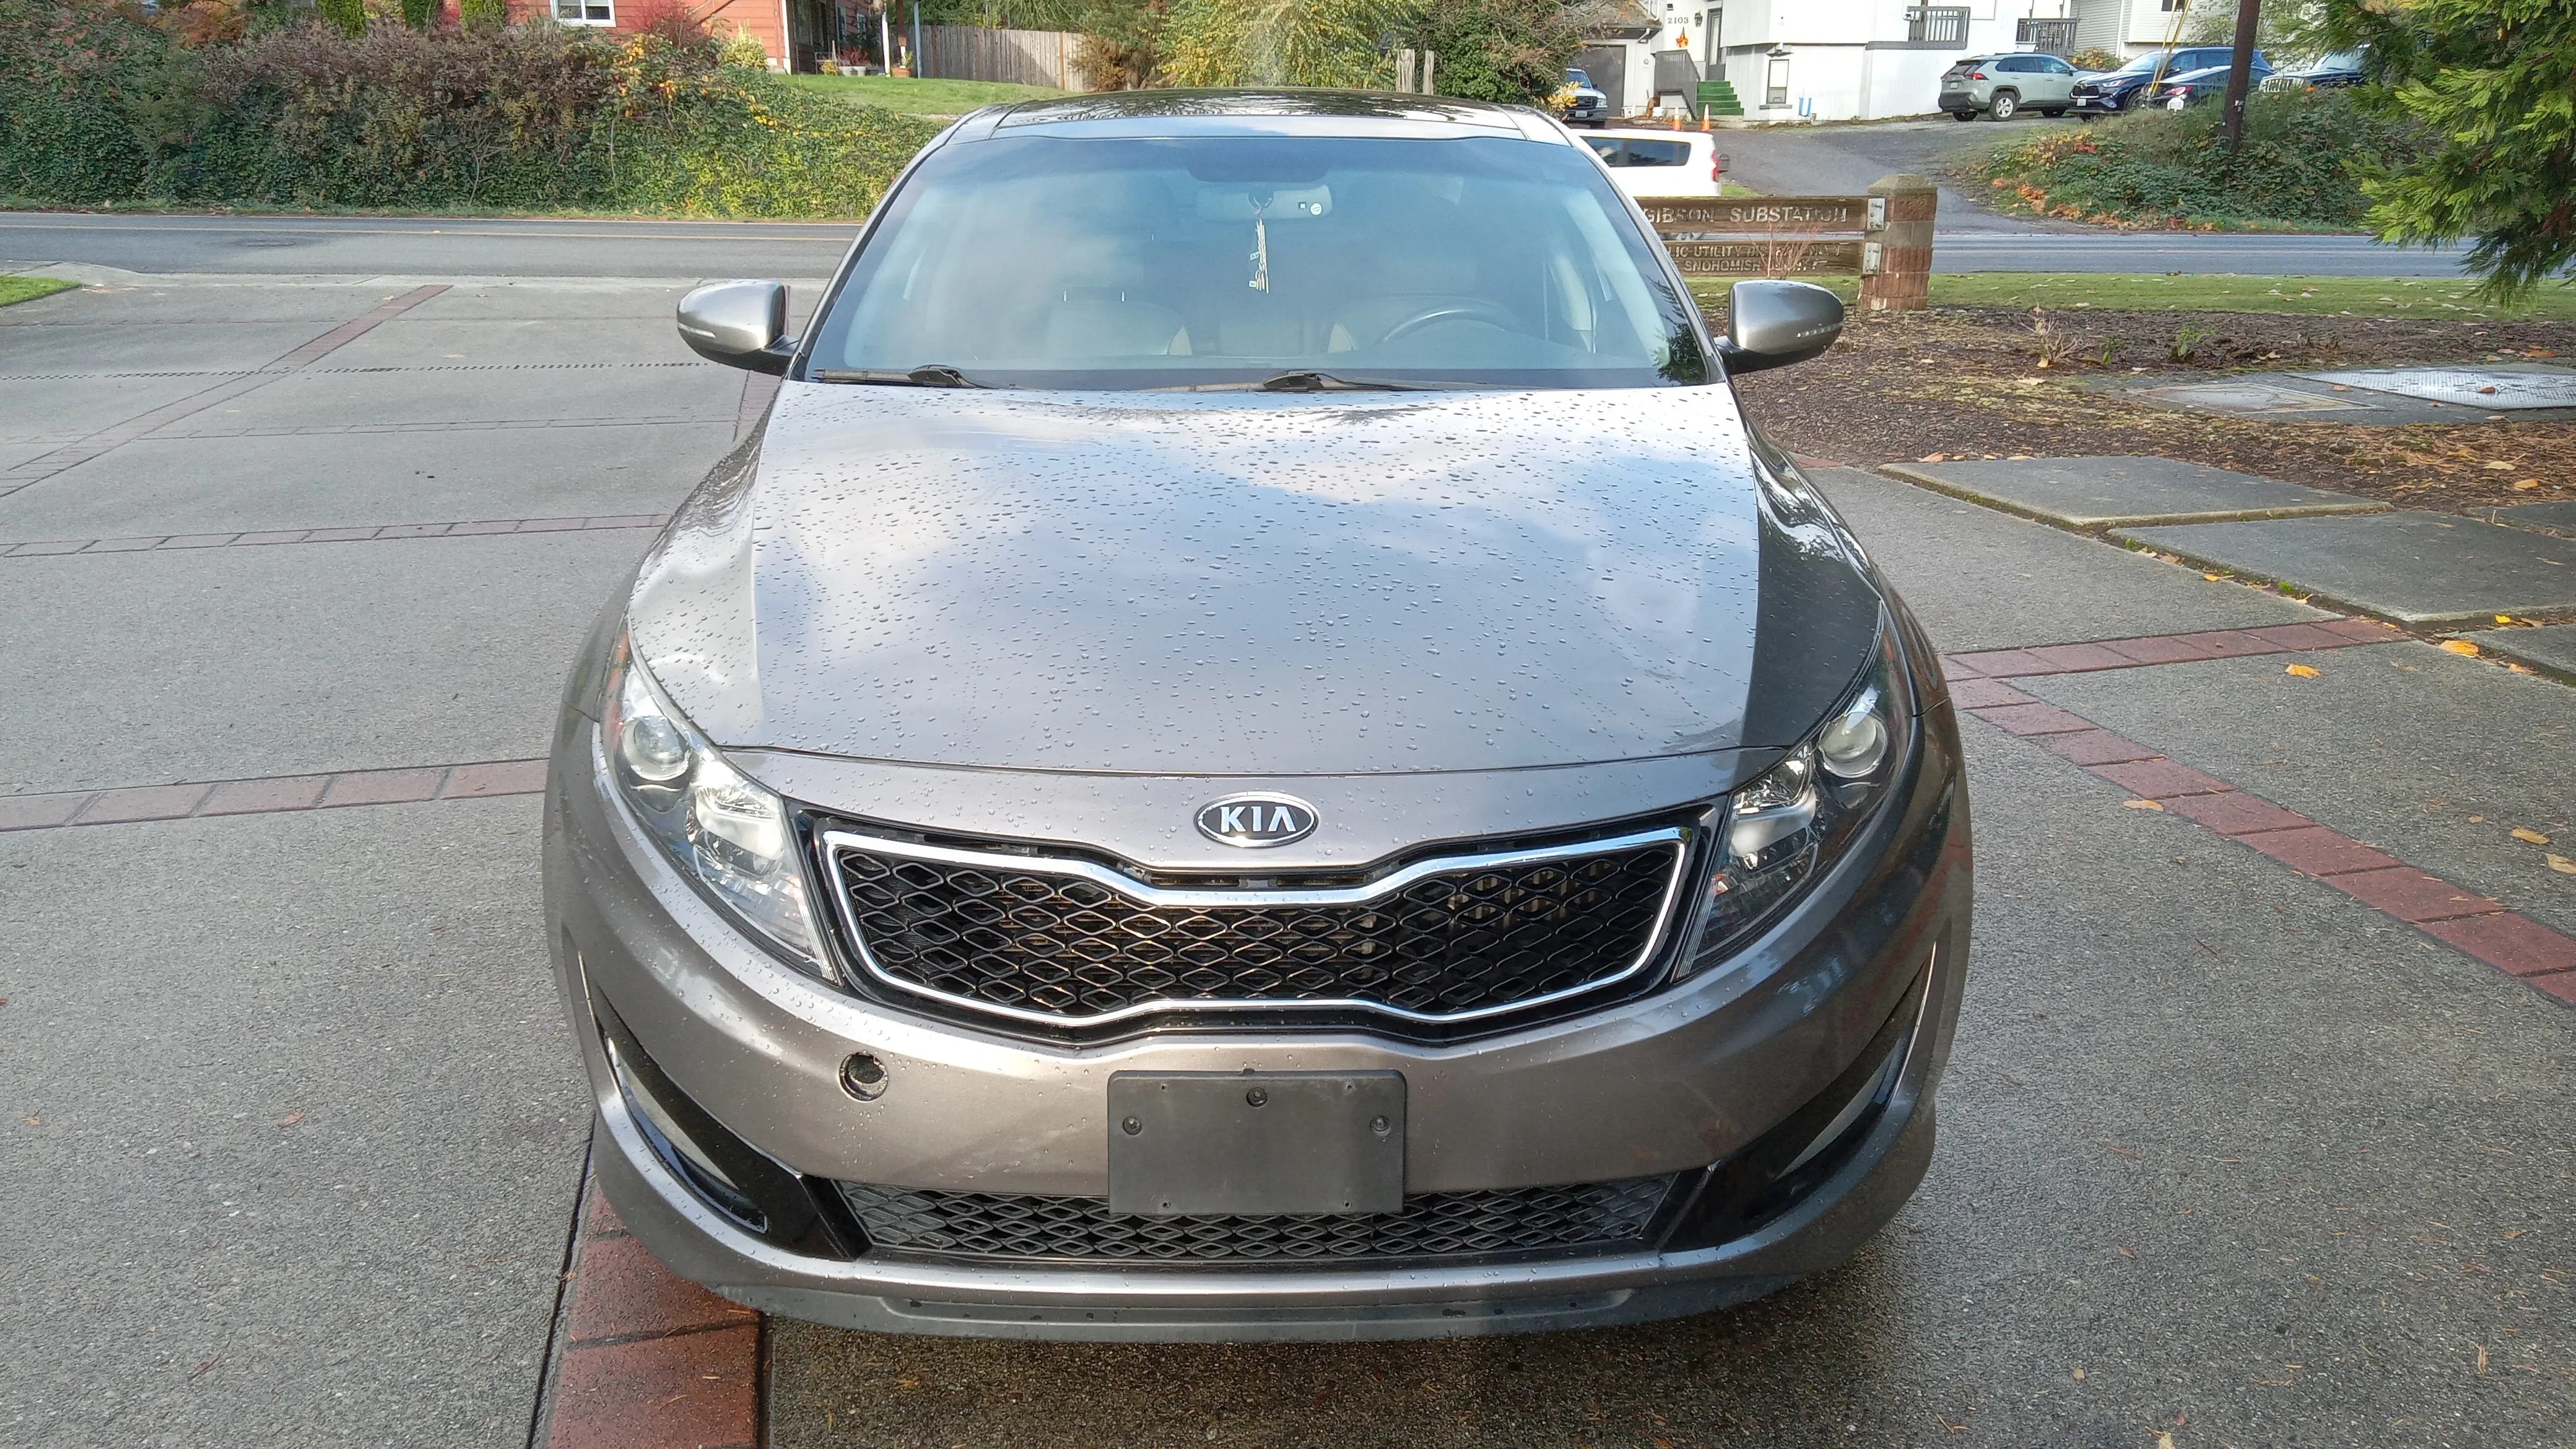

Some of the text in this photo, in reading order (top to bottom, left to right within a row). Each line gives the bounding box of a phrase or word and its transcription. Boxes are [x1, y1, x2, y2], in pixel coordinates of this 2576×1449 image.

[1643, 207, 1715, 224] GIBSON
[1694, 246, 1740, 258] UTILITY
[1220, 806, 1297, 833] KIA
